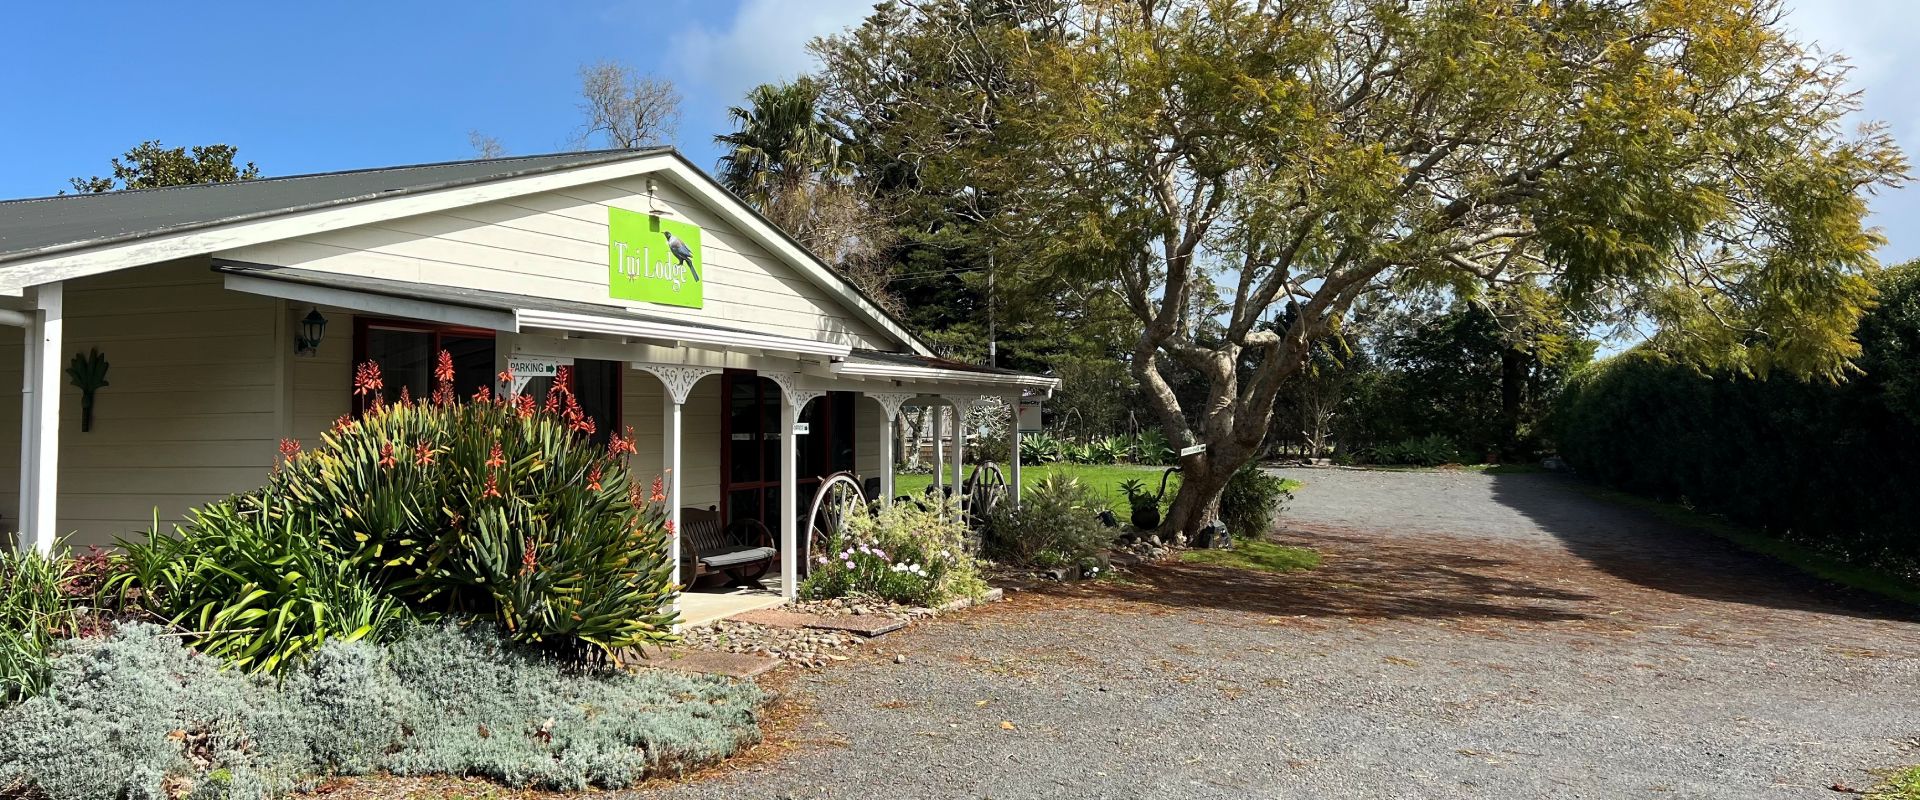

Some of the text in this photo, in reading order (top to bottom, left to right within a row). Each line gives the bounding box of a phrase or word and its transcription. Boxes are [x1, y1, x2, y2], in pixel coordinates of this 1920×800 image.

[614, 241, 687, 292] Tui Lodge
[511, 363, 544, 373] PARKING
